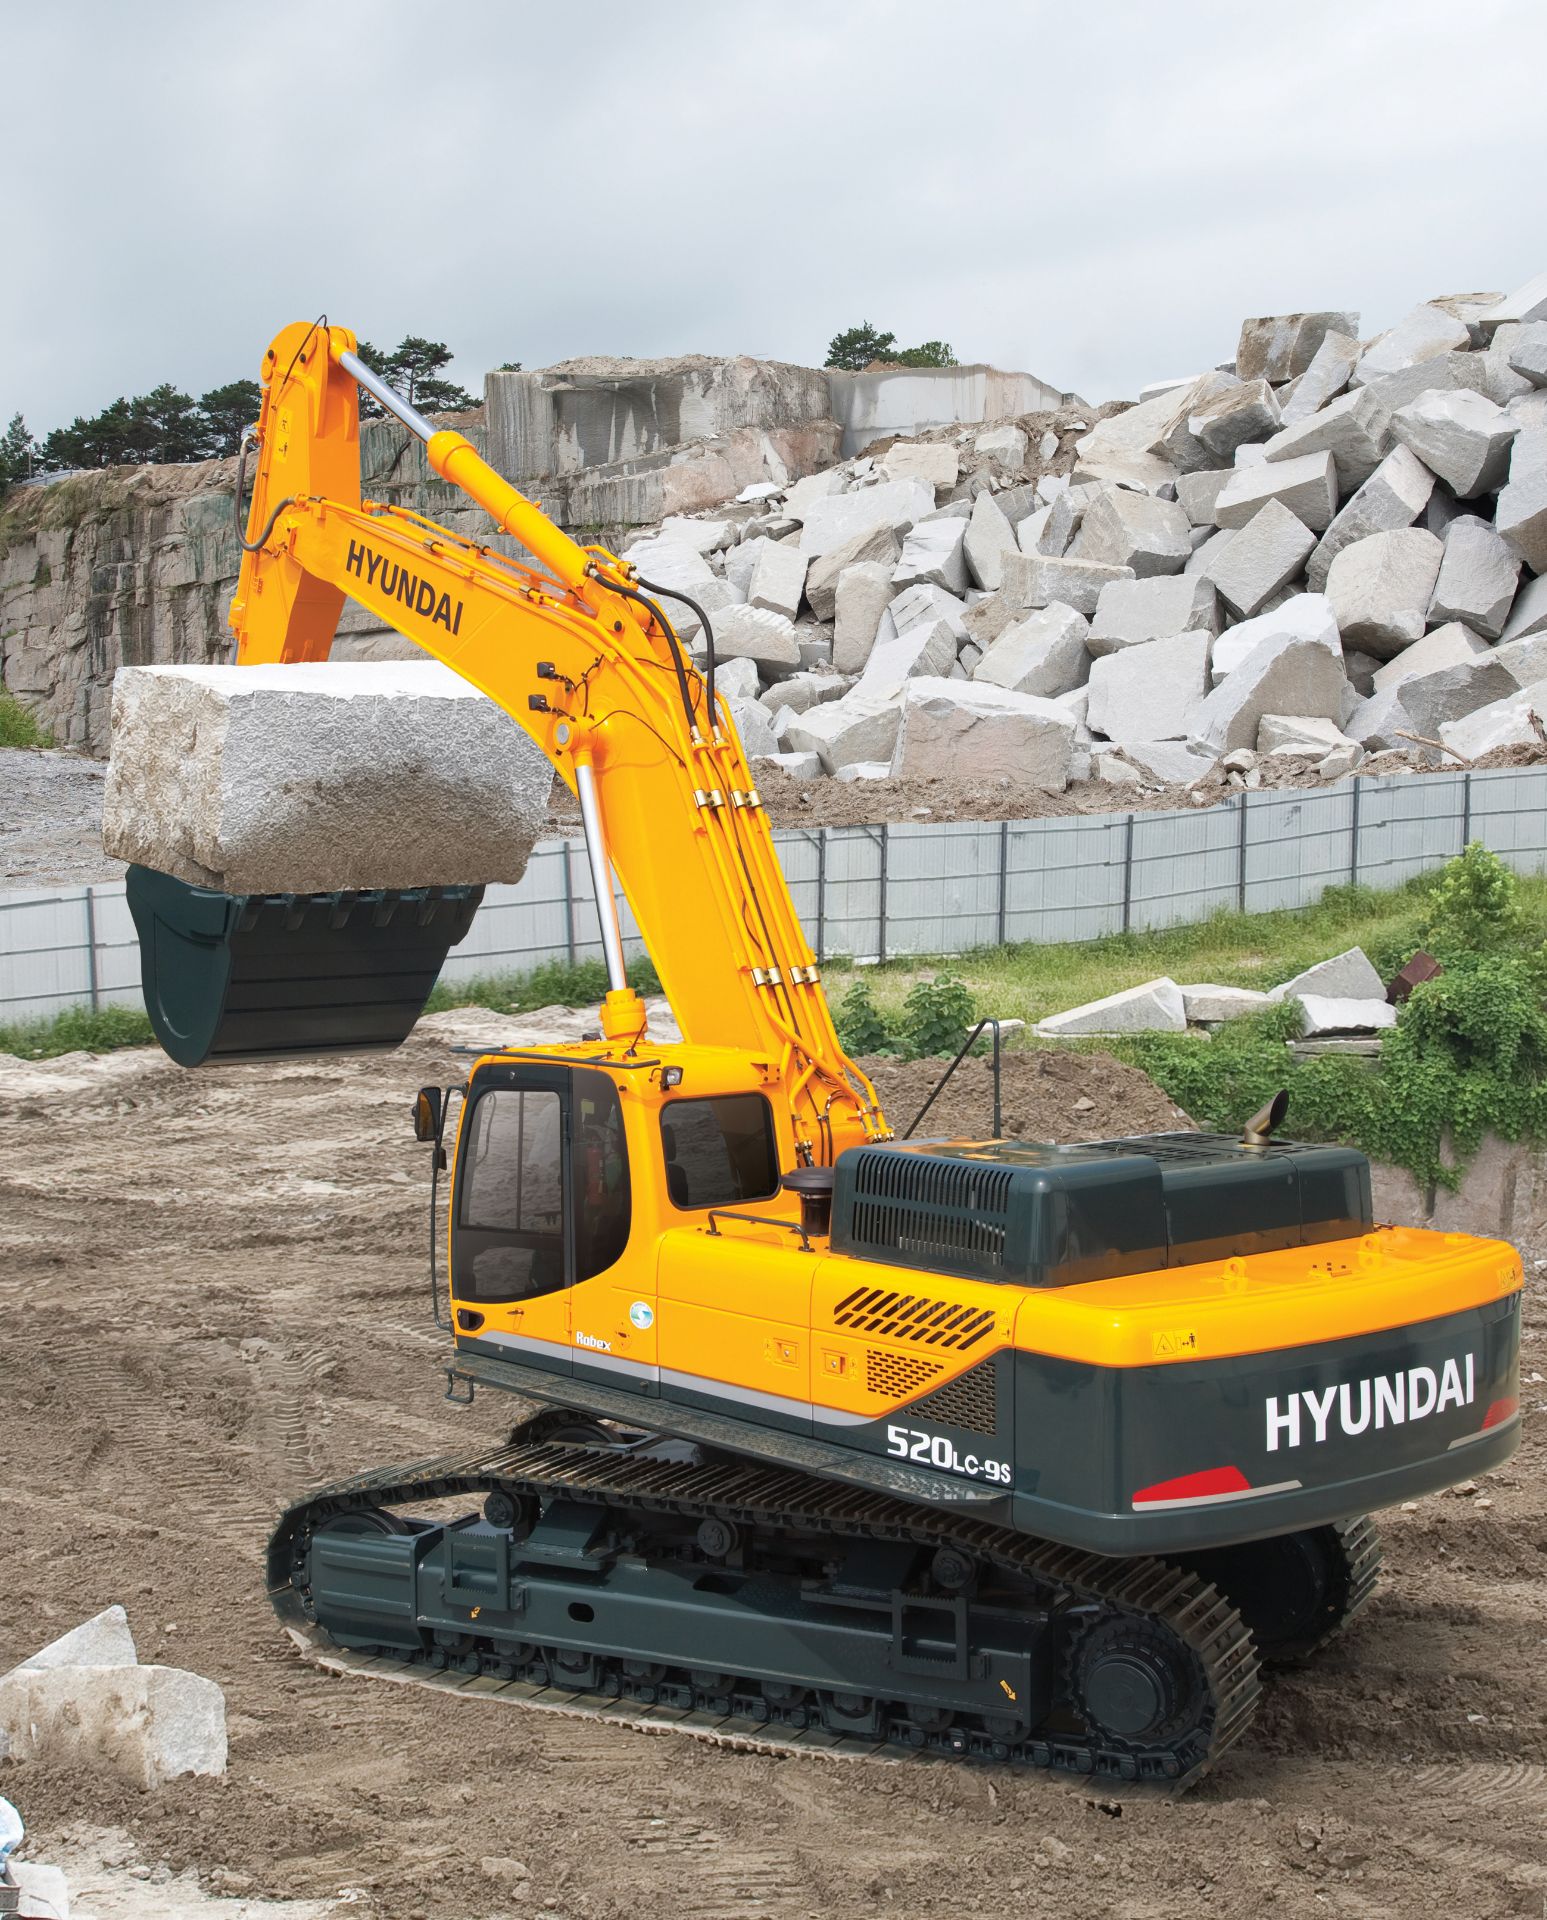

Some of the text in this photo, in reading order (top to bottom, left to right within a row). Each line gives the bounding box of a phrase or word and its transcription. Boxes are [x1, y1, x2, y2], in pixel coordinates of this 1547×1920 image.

[346, 539, 464, 636] HYUNDAI
[575, 1331, 612, 1352] Robex
[1265, 1353, 1475, 1452] HYUNDAI
